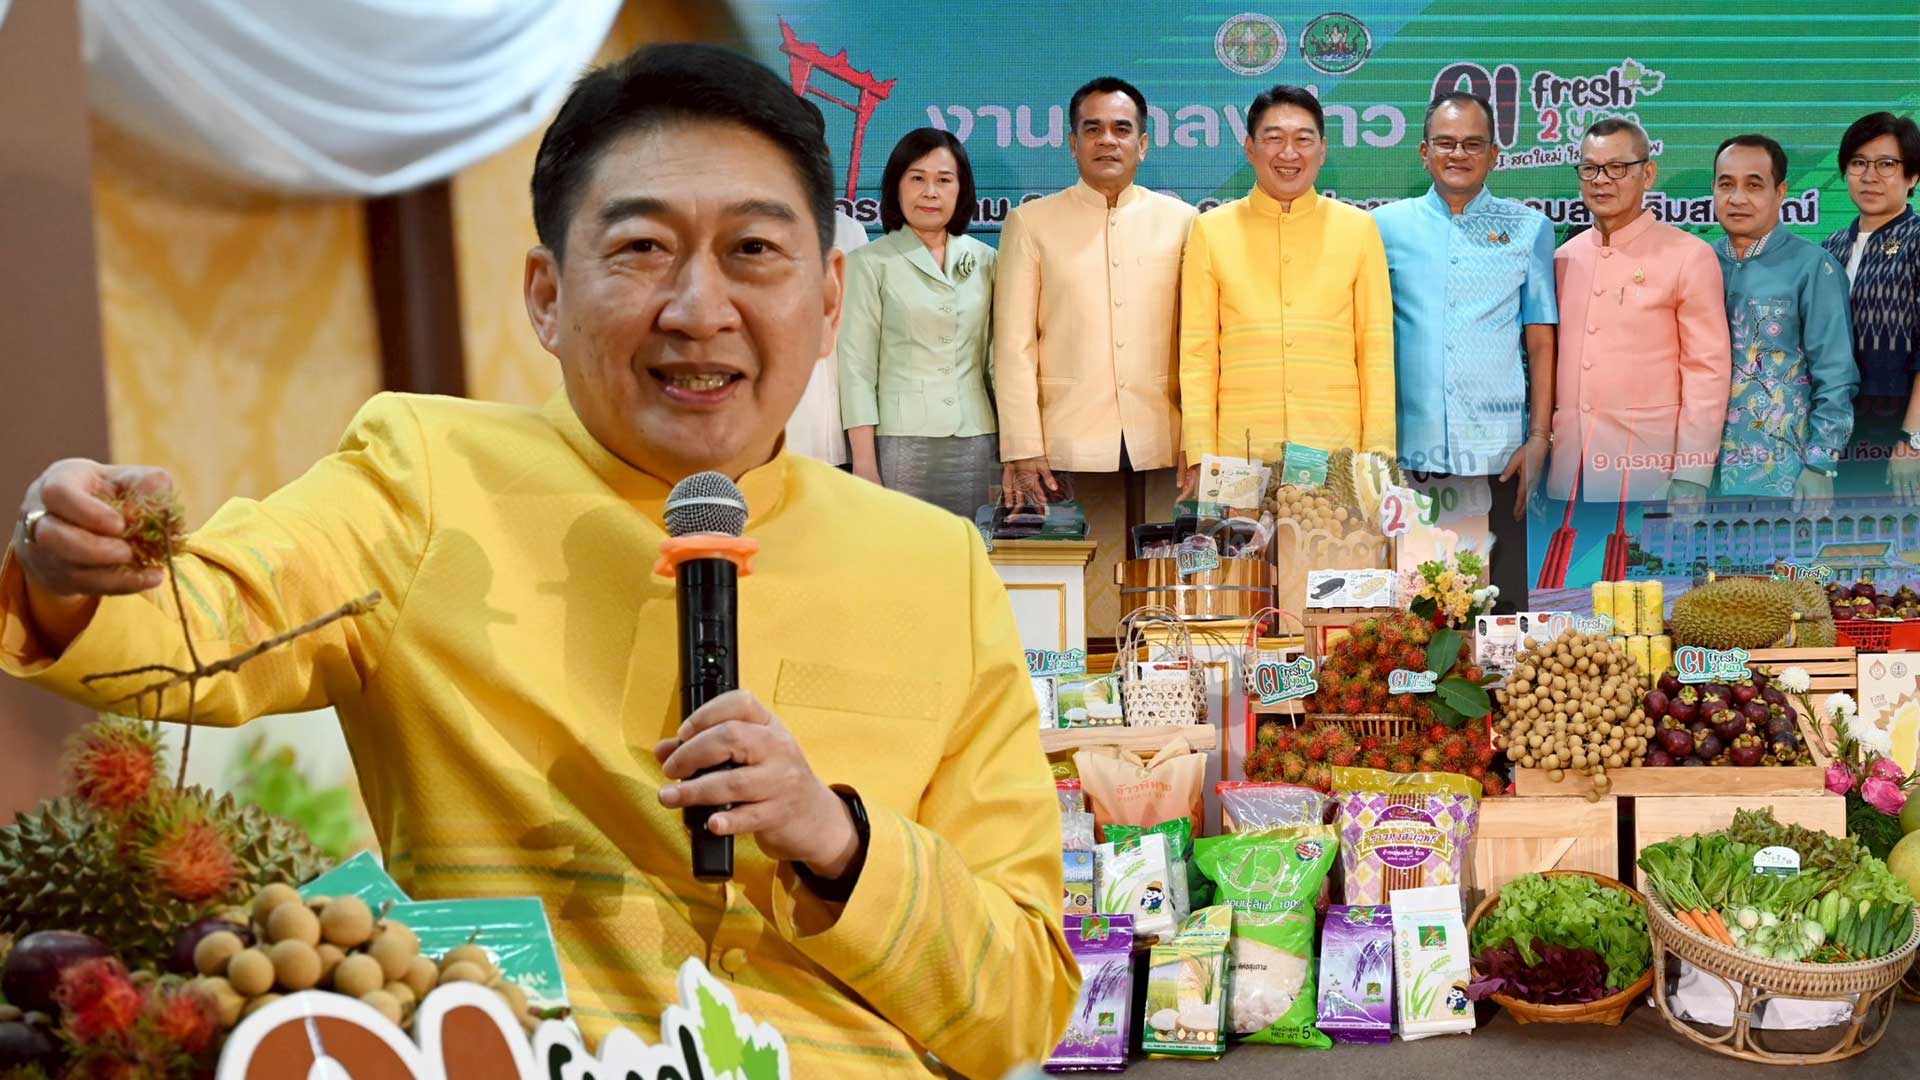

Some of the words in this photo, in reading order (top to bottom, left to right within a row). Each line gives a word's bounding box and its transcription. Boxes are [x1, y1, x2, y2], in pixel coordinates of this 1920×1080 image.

[1533, 70, 1633, 109] fresh
[1541, 110, 1560, 140] 2
[1384, 495, 1405, 532] 2
[1302, 1025, 1311, 1040] 5
